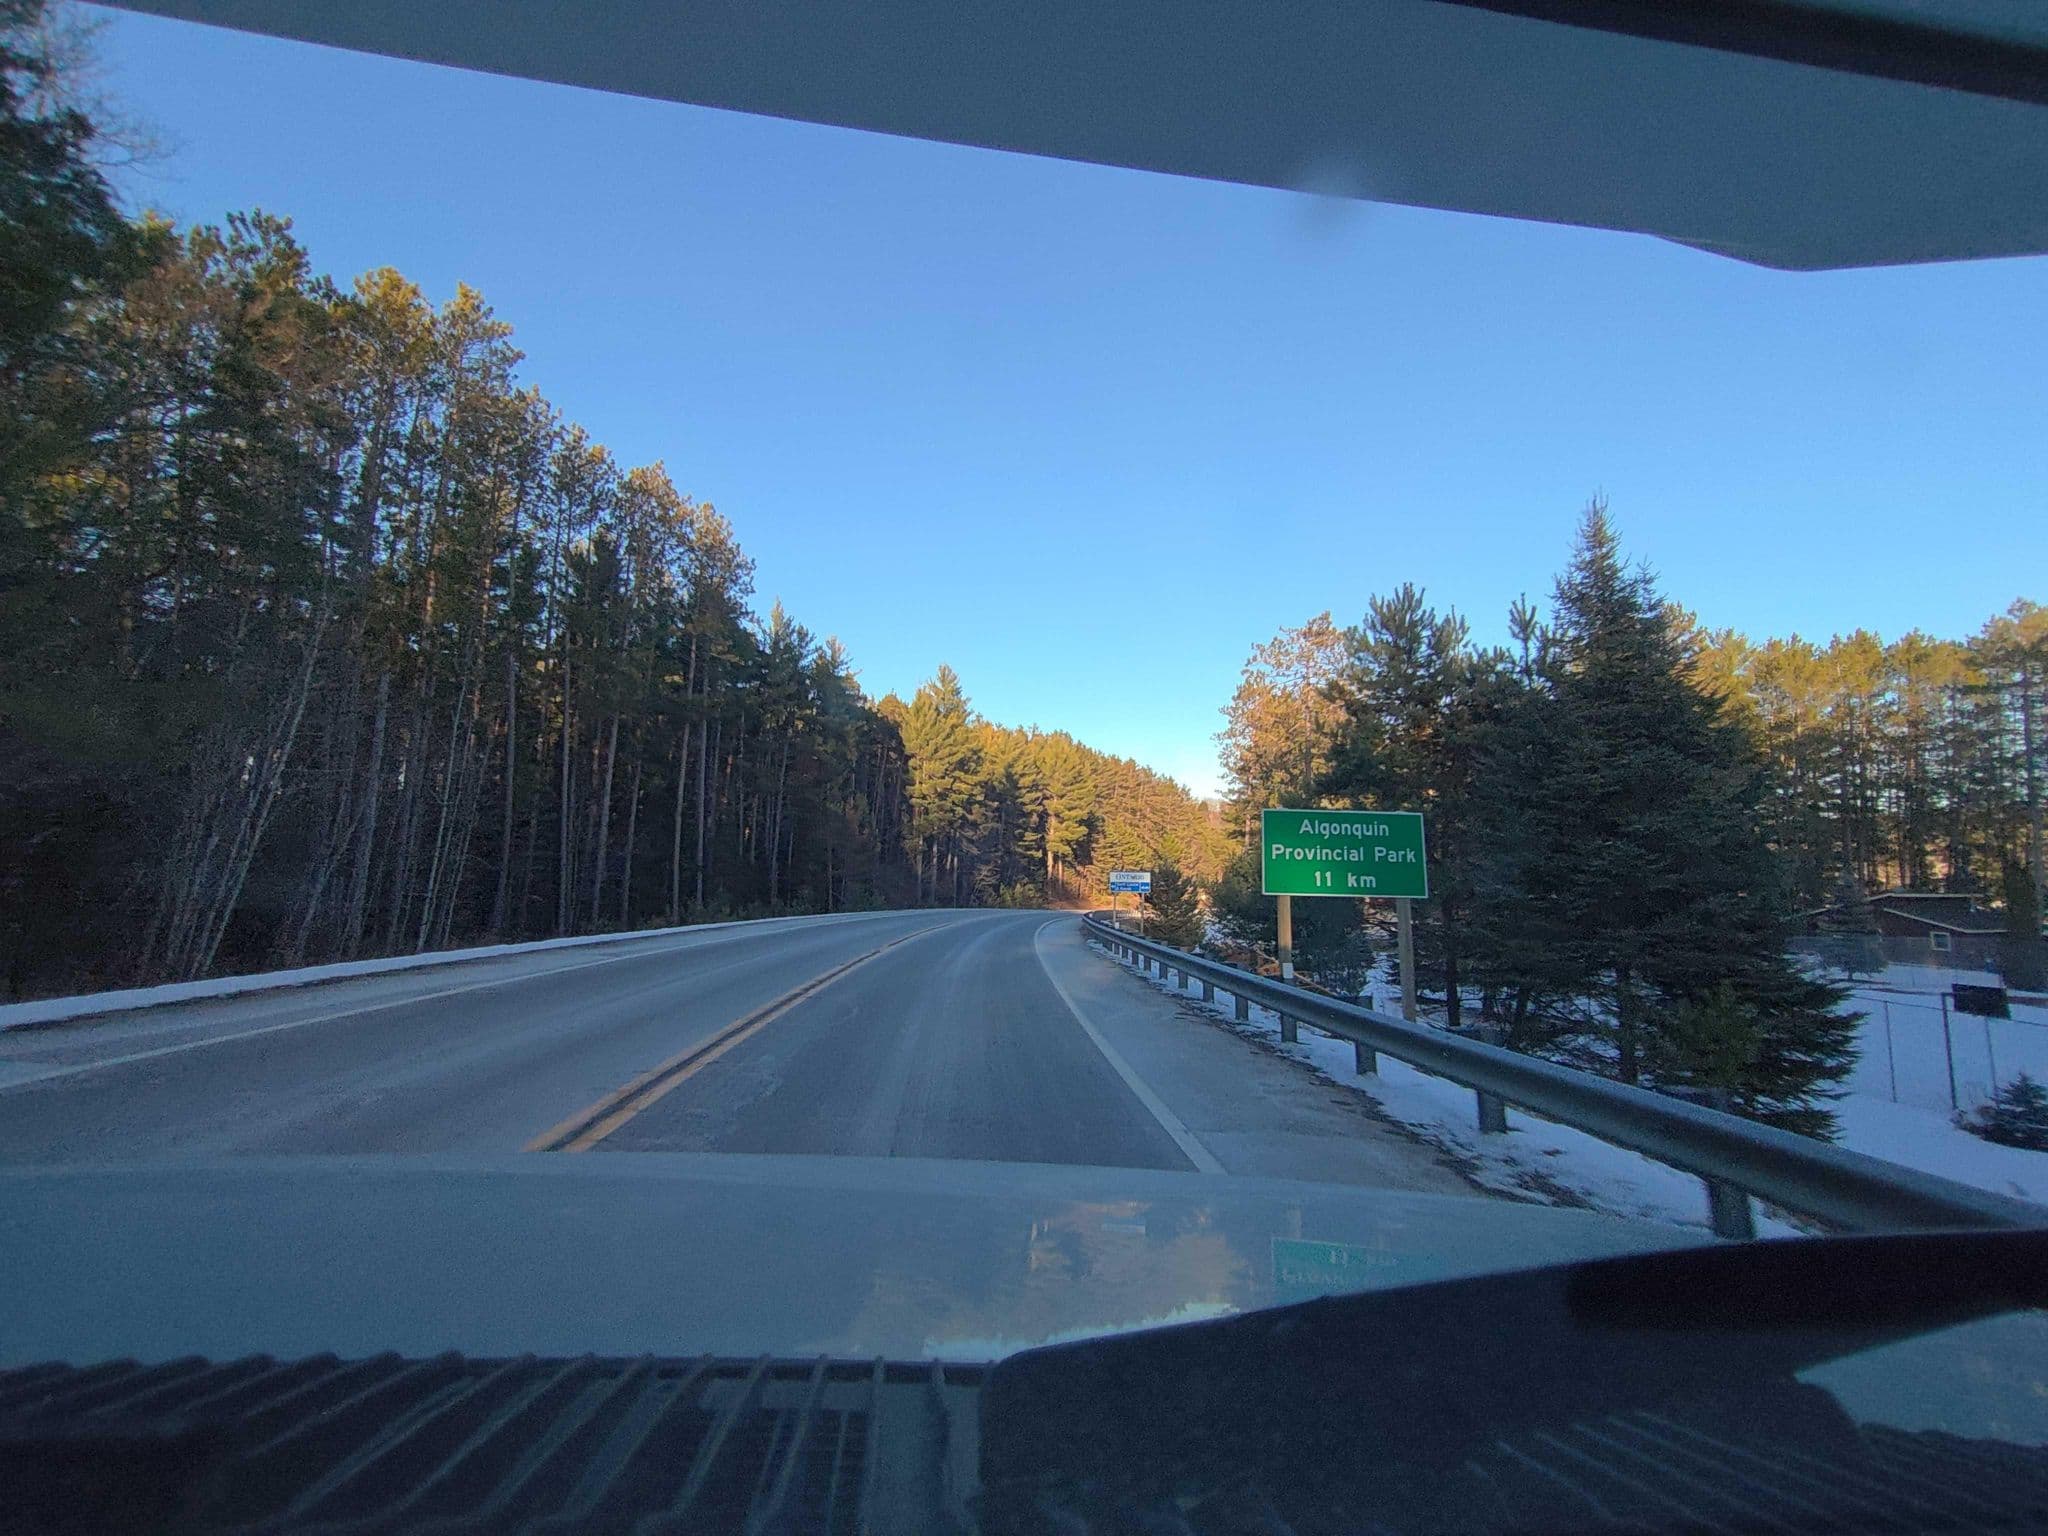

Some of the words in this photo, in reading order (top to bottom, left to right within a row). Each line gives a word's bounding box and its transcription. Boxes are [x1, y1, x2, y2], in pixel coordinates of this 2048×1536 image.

[1299, 819, 1389, 839] Algonquin
[1271, 844, 1364, 861] Provincial
[1374, 846, 1416, 863] Park
[1314, 871, 1332, 887] 11
[1347, 872, 1377, 888] km
